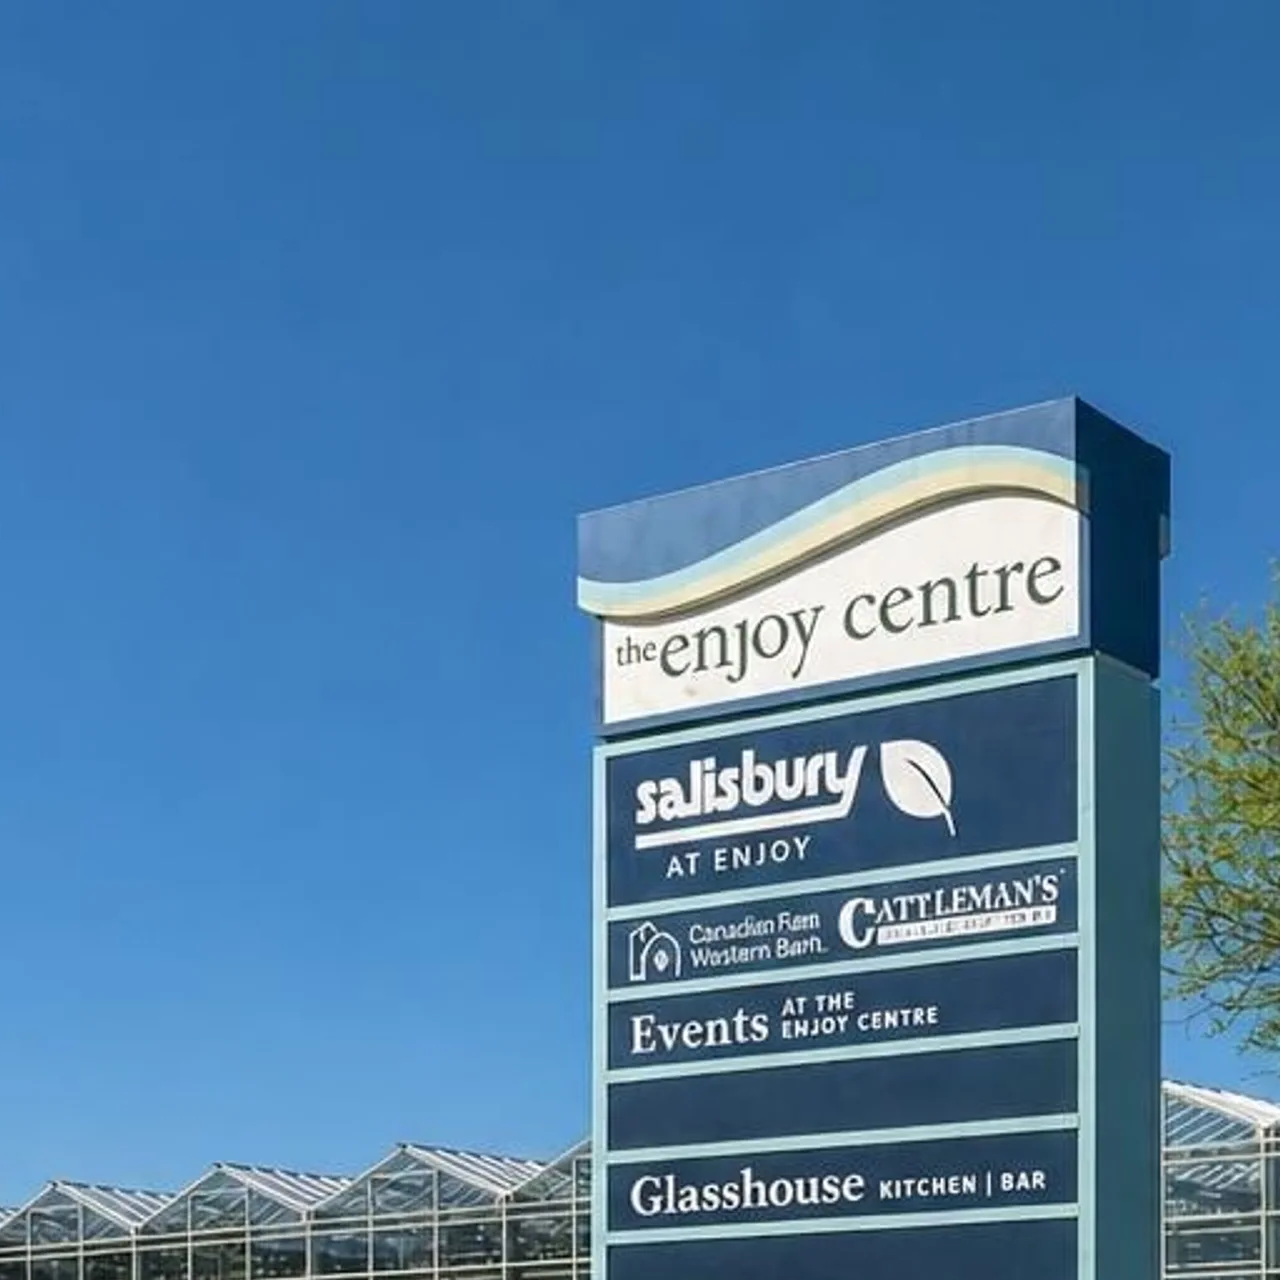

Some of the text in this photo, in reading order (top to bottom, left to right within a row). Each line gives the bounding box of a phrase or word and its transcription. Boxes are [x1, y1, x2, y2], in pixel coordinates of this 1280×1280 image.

[616, 554, 1065, 683] the enjoy centre
[635, 744, 867, 824] salisbury
[666, 836, 811, 878] AT ENJOY
[838, 874, 1059, 949] CATTLEMAN'S
[781, 991, 855, 1016] AT THE
[781, 1006, 939, 1039] ENJOY CENTRE
[629, 1008, 769, 1054] Events
[630, 1167, 865, 1216] Glasshouse
[879, 1174, 977, 1199] KITCHEN
[1000, 1170, 1046, 1191] BAR
